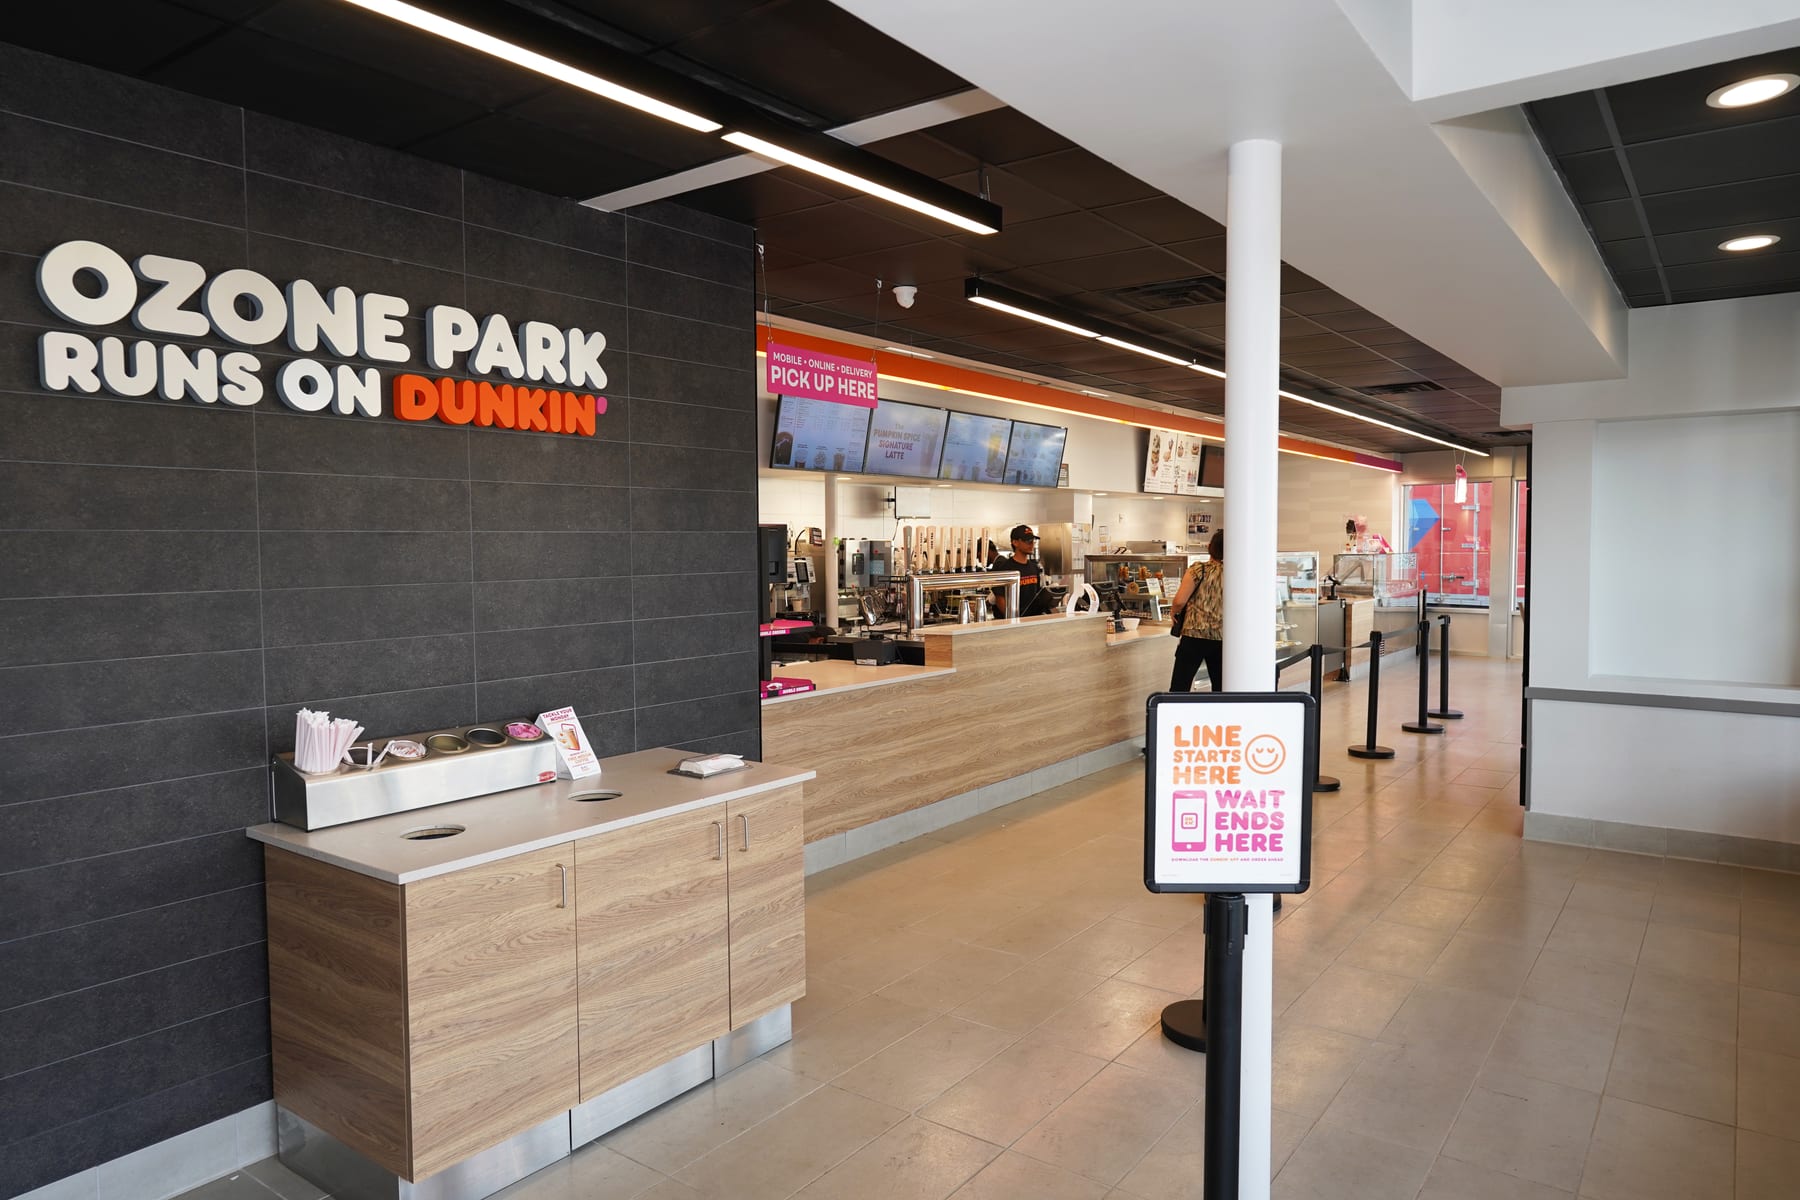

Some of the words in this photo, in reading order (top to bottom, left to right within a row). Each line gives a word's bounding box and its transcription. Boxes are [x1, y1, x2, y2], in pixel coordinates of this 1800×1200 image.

[36, 240, 411, 364] OZONE
[426, 304, 608, 391] PARK
[773, 352, 802, 366] MOBILE
[808, 359, 836, 372] ONLINE
[841, 365, 873, 379] DELIVERY
[38, 330, 265, 407] RUNS
[276, 357, 382, 418] ON
[392, 373, 608, 437] DUNKIN'
[771, 365, 810, 390] PICK
[814, 372, 835, 393] UP
[838, 377, 876, 400] HERE
[879, 440, 914, 451] SIGNATURE
[885, 450, 905, 460] LATTE
[1174, 725, 1242, 748] LINE
[1173, 750, 1241, 763] STARTS
[1173, 765, 1241, 785] HERE
[1215, 789, 1286, 809] WAIT
[1215, 811, 1285, 831] ENDS
[1215, 833, 1284, 852] HERE
